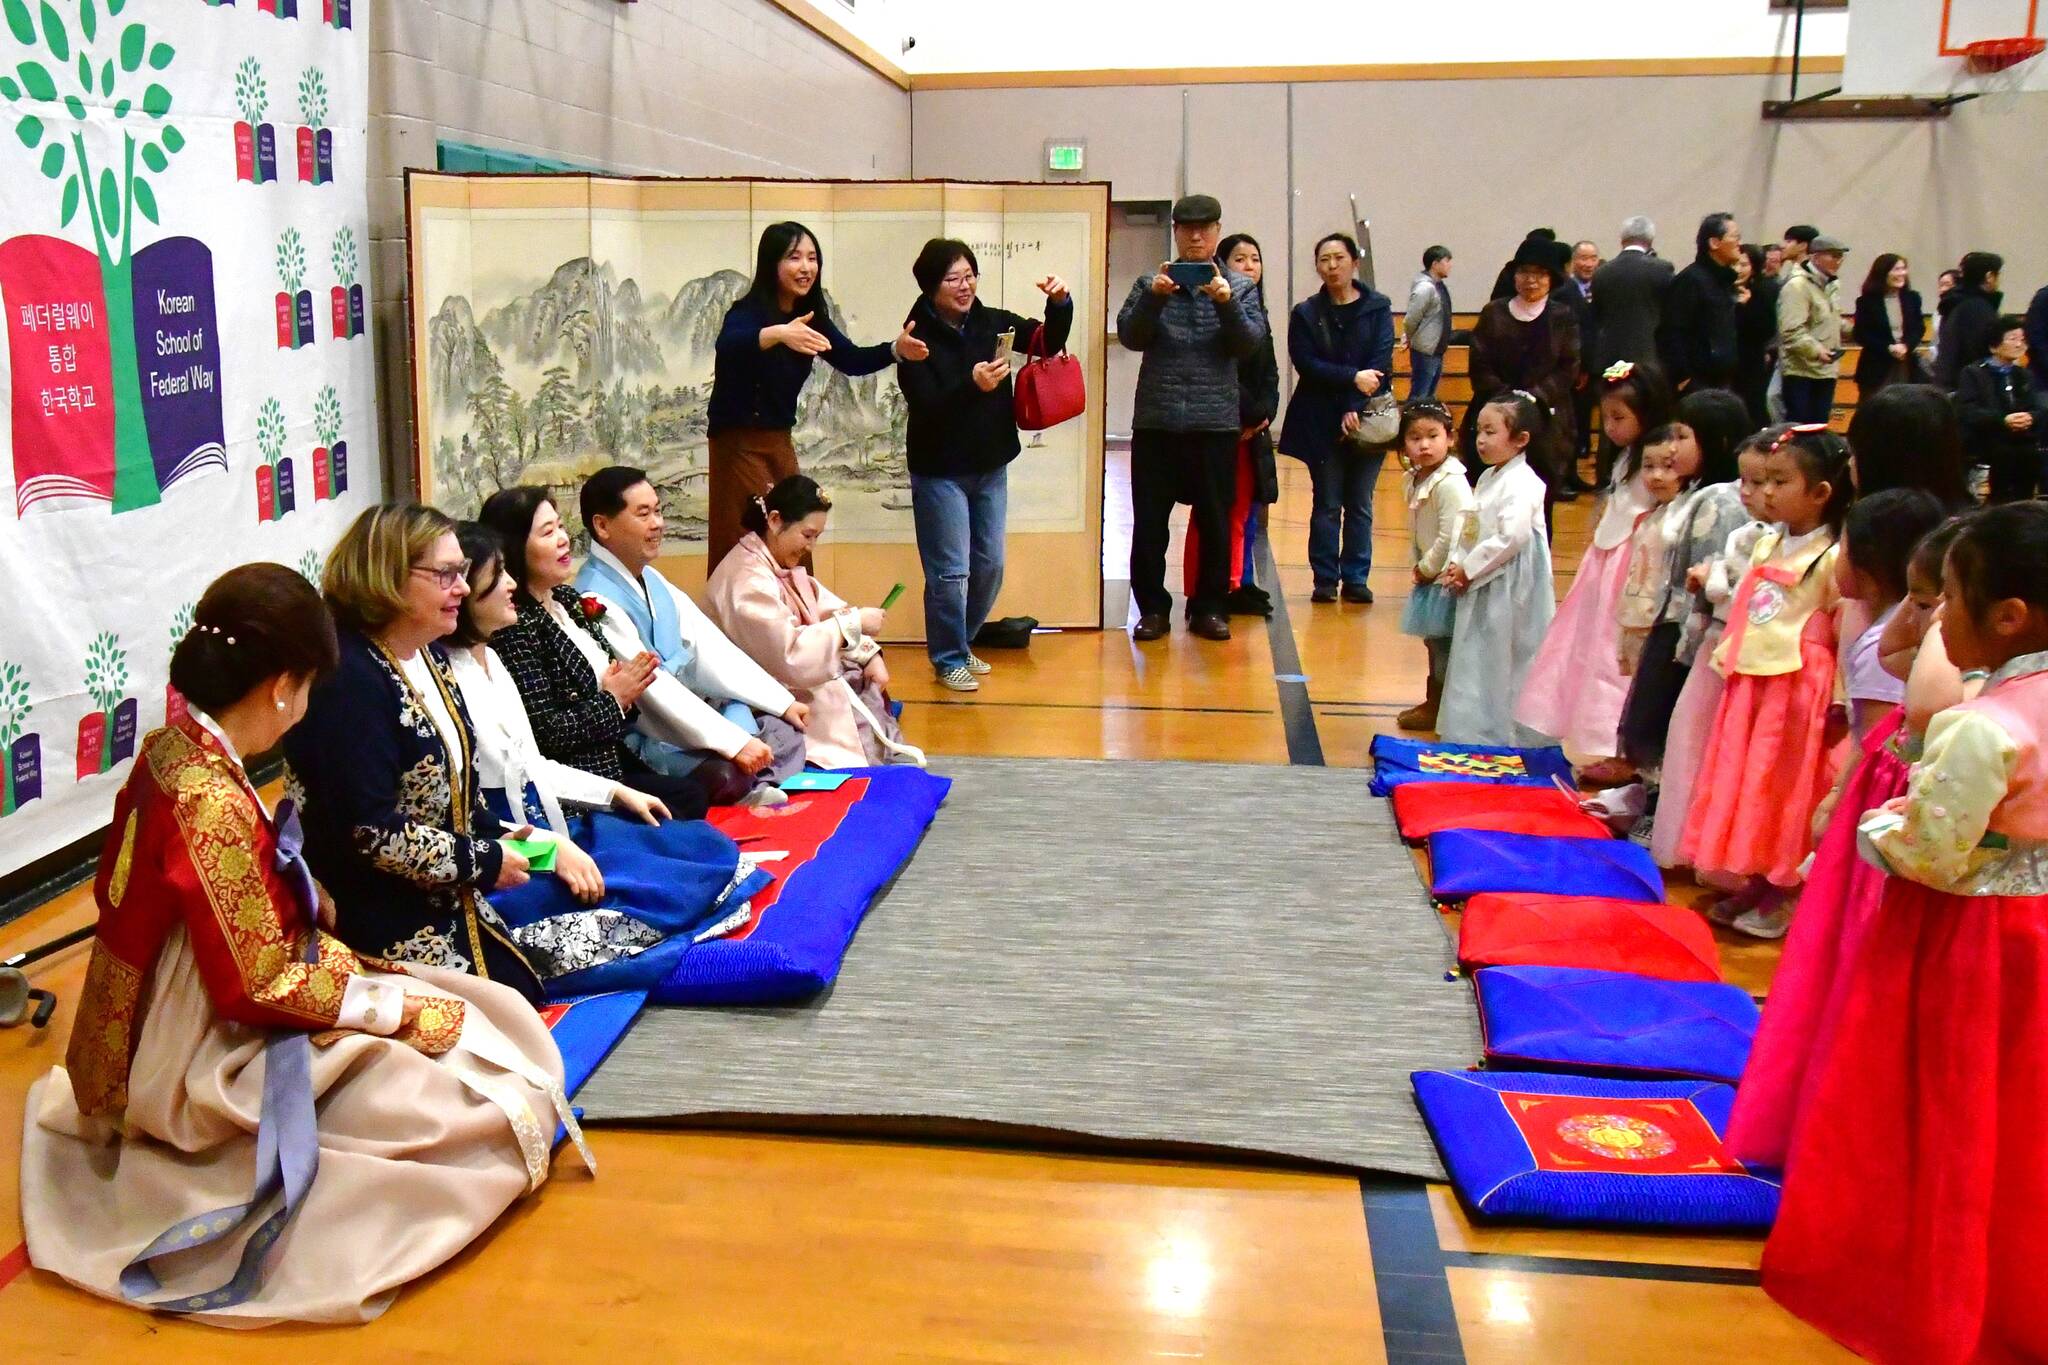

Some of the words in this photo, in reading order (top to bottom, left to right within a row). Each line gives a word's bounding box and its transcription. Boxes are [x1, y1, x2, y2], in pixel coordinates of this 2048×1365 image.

[20, 301, 95, 332] 페더럴웨이
[157, 289, 195, 315] Korean
[156, 328, 192, 356] School
[192, 327, 203, 351] of
[48, 344, 77, 374] 통합
[150, 369, 189, 398] Federal
[190, 364, 214, 393] Way
[40, 385, 97, 417] 한국학교
